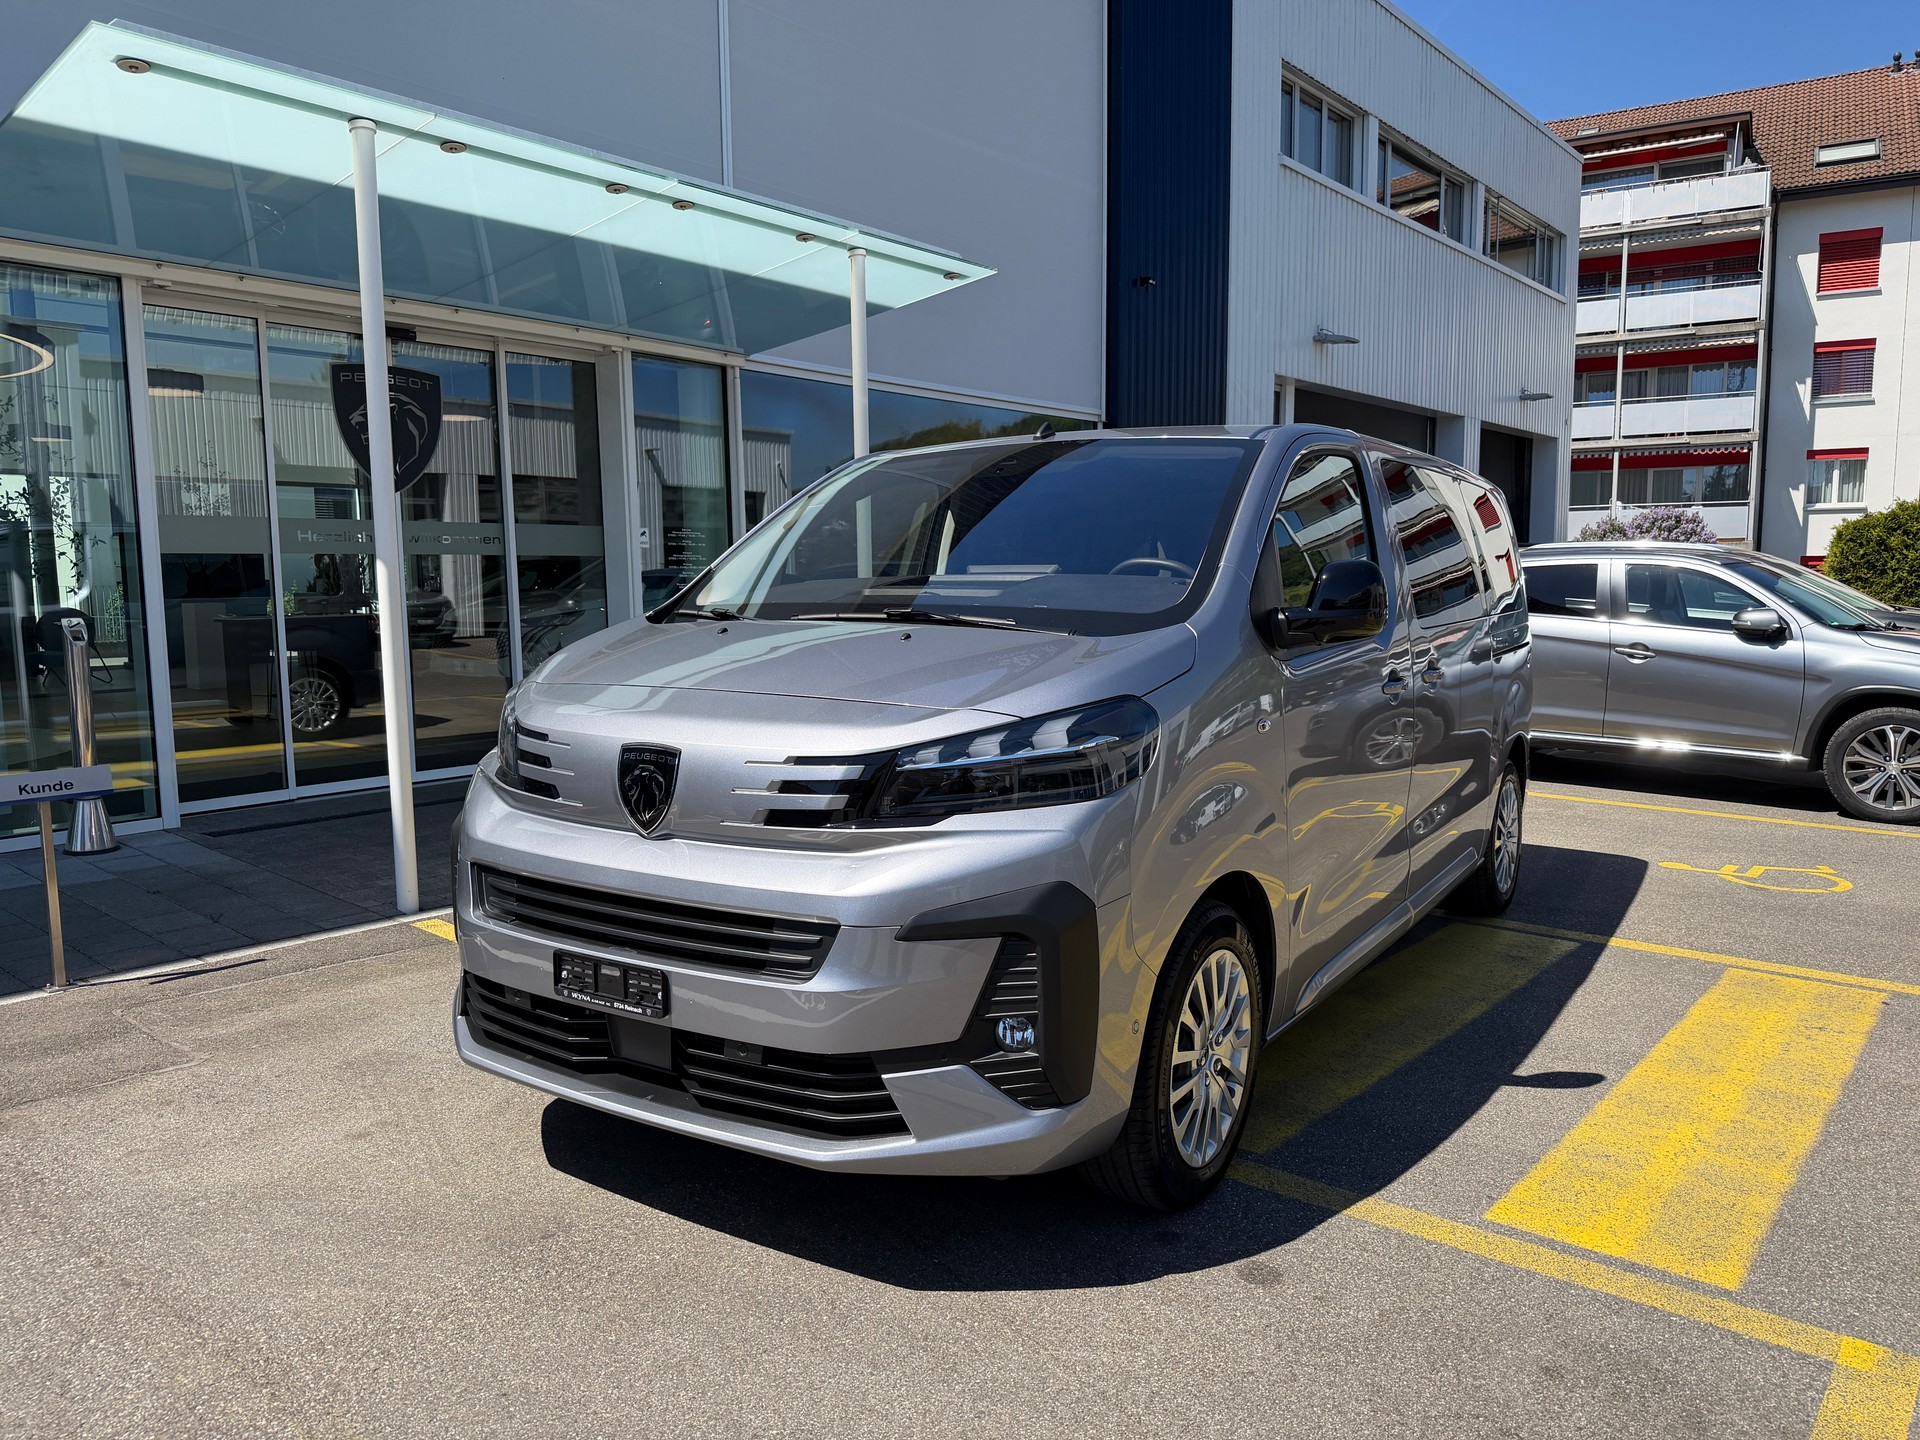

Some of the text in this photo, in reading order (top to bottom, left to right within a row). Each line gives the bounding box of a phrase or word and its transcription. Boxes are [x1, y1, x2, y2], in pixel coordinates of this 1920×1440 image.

[340, 372, 434, 391] PEGEOT
[623, 752, 673, 765] PEUGEOT
[18, 780, 74, 796] Kunde
[624, 1004, 643, 1014] Reinach
